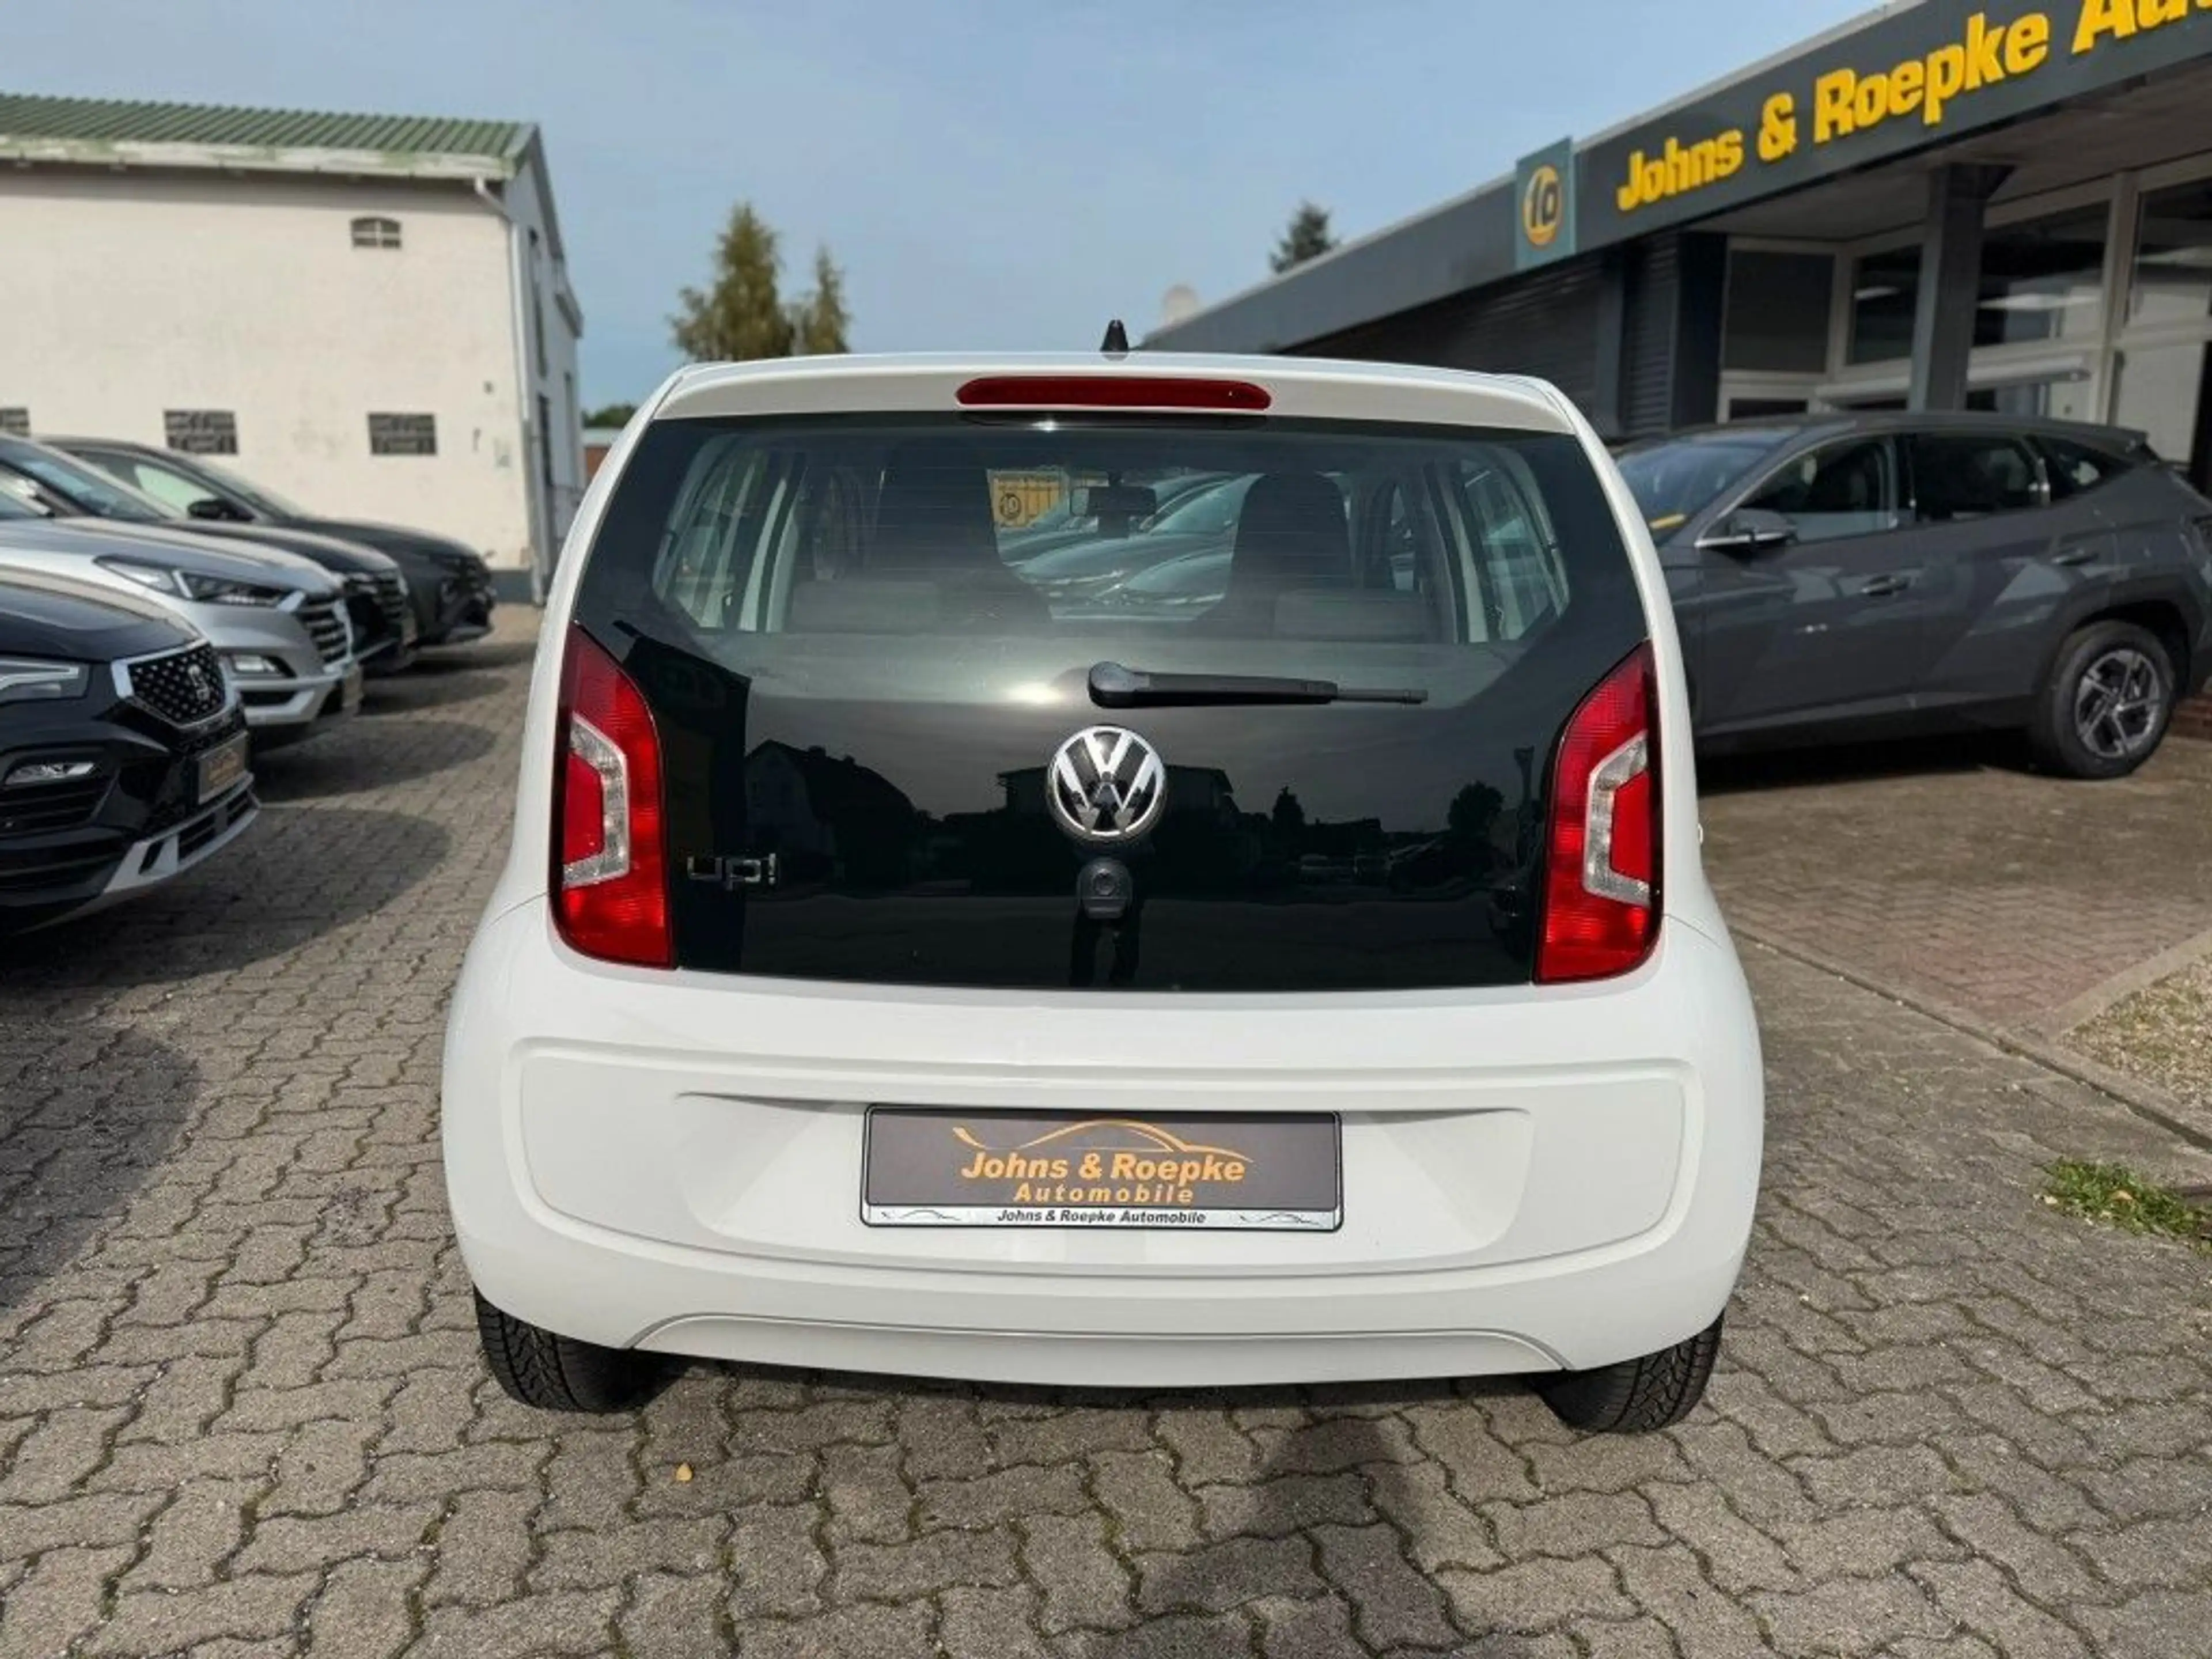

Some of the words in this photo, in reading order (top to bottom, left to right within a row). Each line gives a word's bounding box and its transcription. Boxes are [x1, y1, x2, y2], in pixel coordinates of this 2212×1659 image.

[1617, 128, 1744, 211] Johns
[1758, 92, 1797, 161] &
[1814, 12, 2050, 143] Roepke
[961, 1152, 1069, 1179] Johns
[1078, 1152, 1103, 1179] &
[1110, 1153, 1245, 1187] Roepke
[1013, 1182, 1194, 1203] Automobile
[997, 1209, 1042, 1222] Johns
[1046, 1210, 1056, 1221] &
[1060, 1209, 1116, 1224] Roepke
[1120, 1210, 1207, 1224] Automobile
